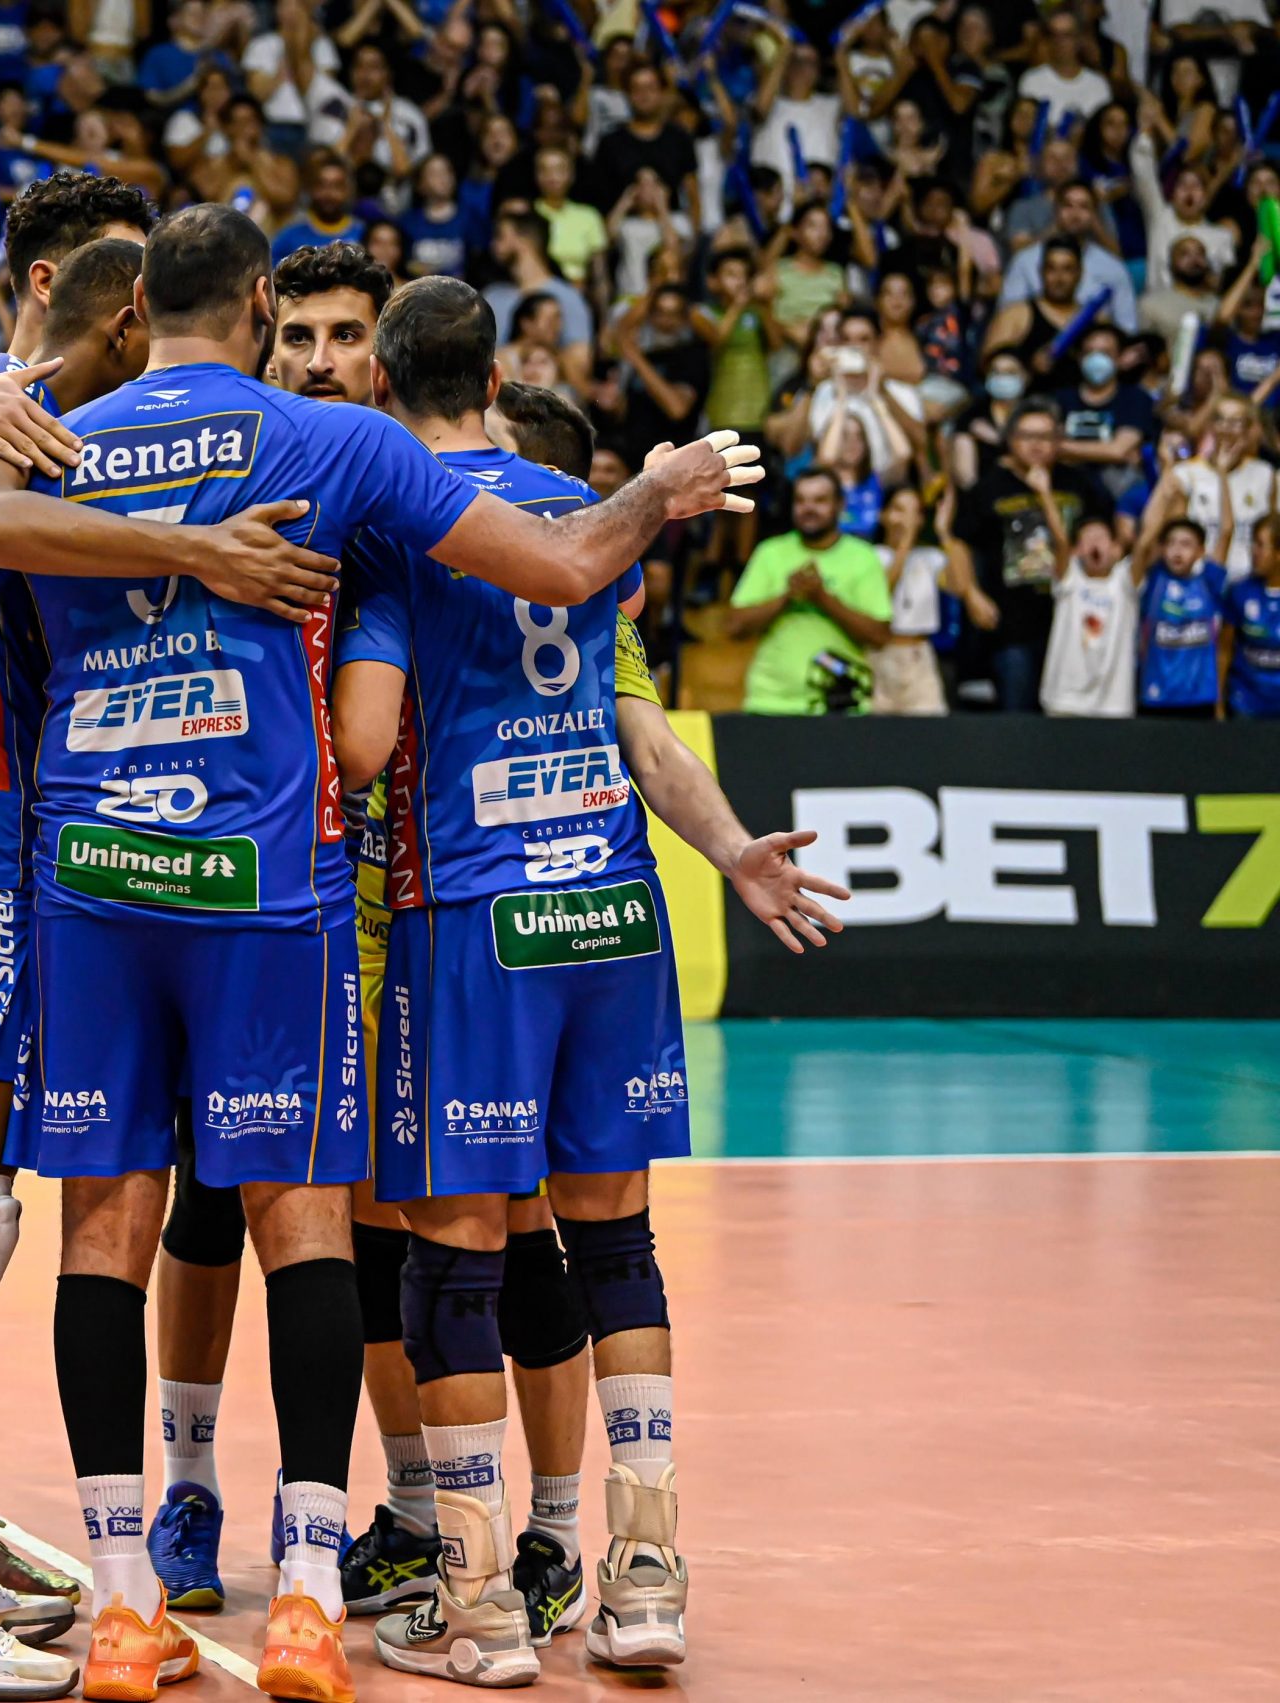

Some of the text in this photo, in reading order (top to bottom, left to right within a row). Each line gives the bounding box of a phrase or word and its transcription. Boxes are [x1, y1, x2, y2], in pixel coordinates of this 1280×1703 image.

[136, 399, 189, 411] PENALTY
[71, 427, 243, 486] Renata
[83, 632, 198, 672] MAURÍCIO
[514, 594, 580, 696] 8
[96, 676, 215, 727] EVER
[181, 714, 243, 737] EXPRESS
[497, 708, 605, 741] GONZALEZ
[103, 757, 206, 777] CAMPINAS
[506, 750, 612, 800] EVER
[96, 773, 208, 823] 250
[583, 785, 629, 808] EXPRESS
[522, 818, 606, 839] CAMPINAS
[70, 841, 192, 876] Unimed
[127, 877, 191, 895] Campinas
[514, 908, 619, 936] Unimed
[571, 935, 621, 951] Campinas
[342, 973, 357, 1087] Sicredi
[395, 985, 414, 1101] Sicredi
[228, 1092, 302, 1113] SANASA
[469, 1098, 538, 1118] SANASA
[208, 1110, 301, 1125] CAMPINAS
[267, 1125, 287, 1136] lugar
[473, 1136, 488, 1144] vida
[501, 1136, 526, 1145] primeiro
